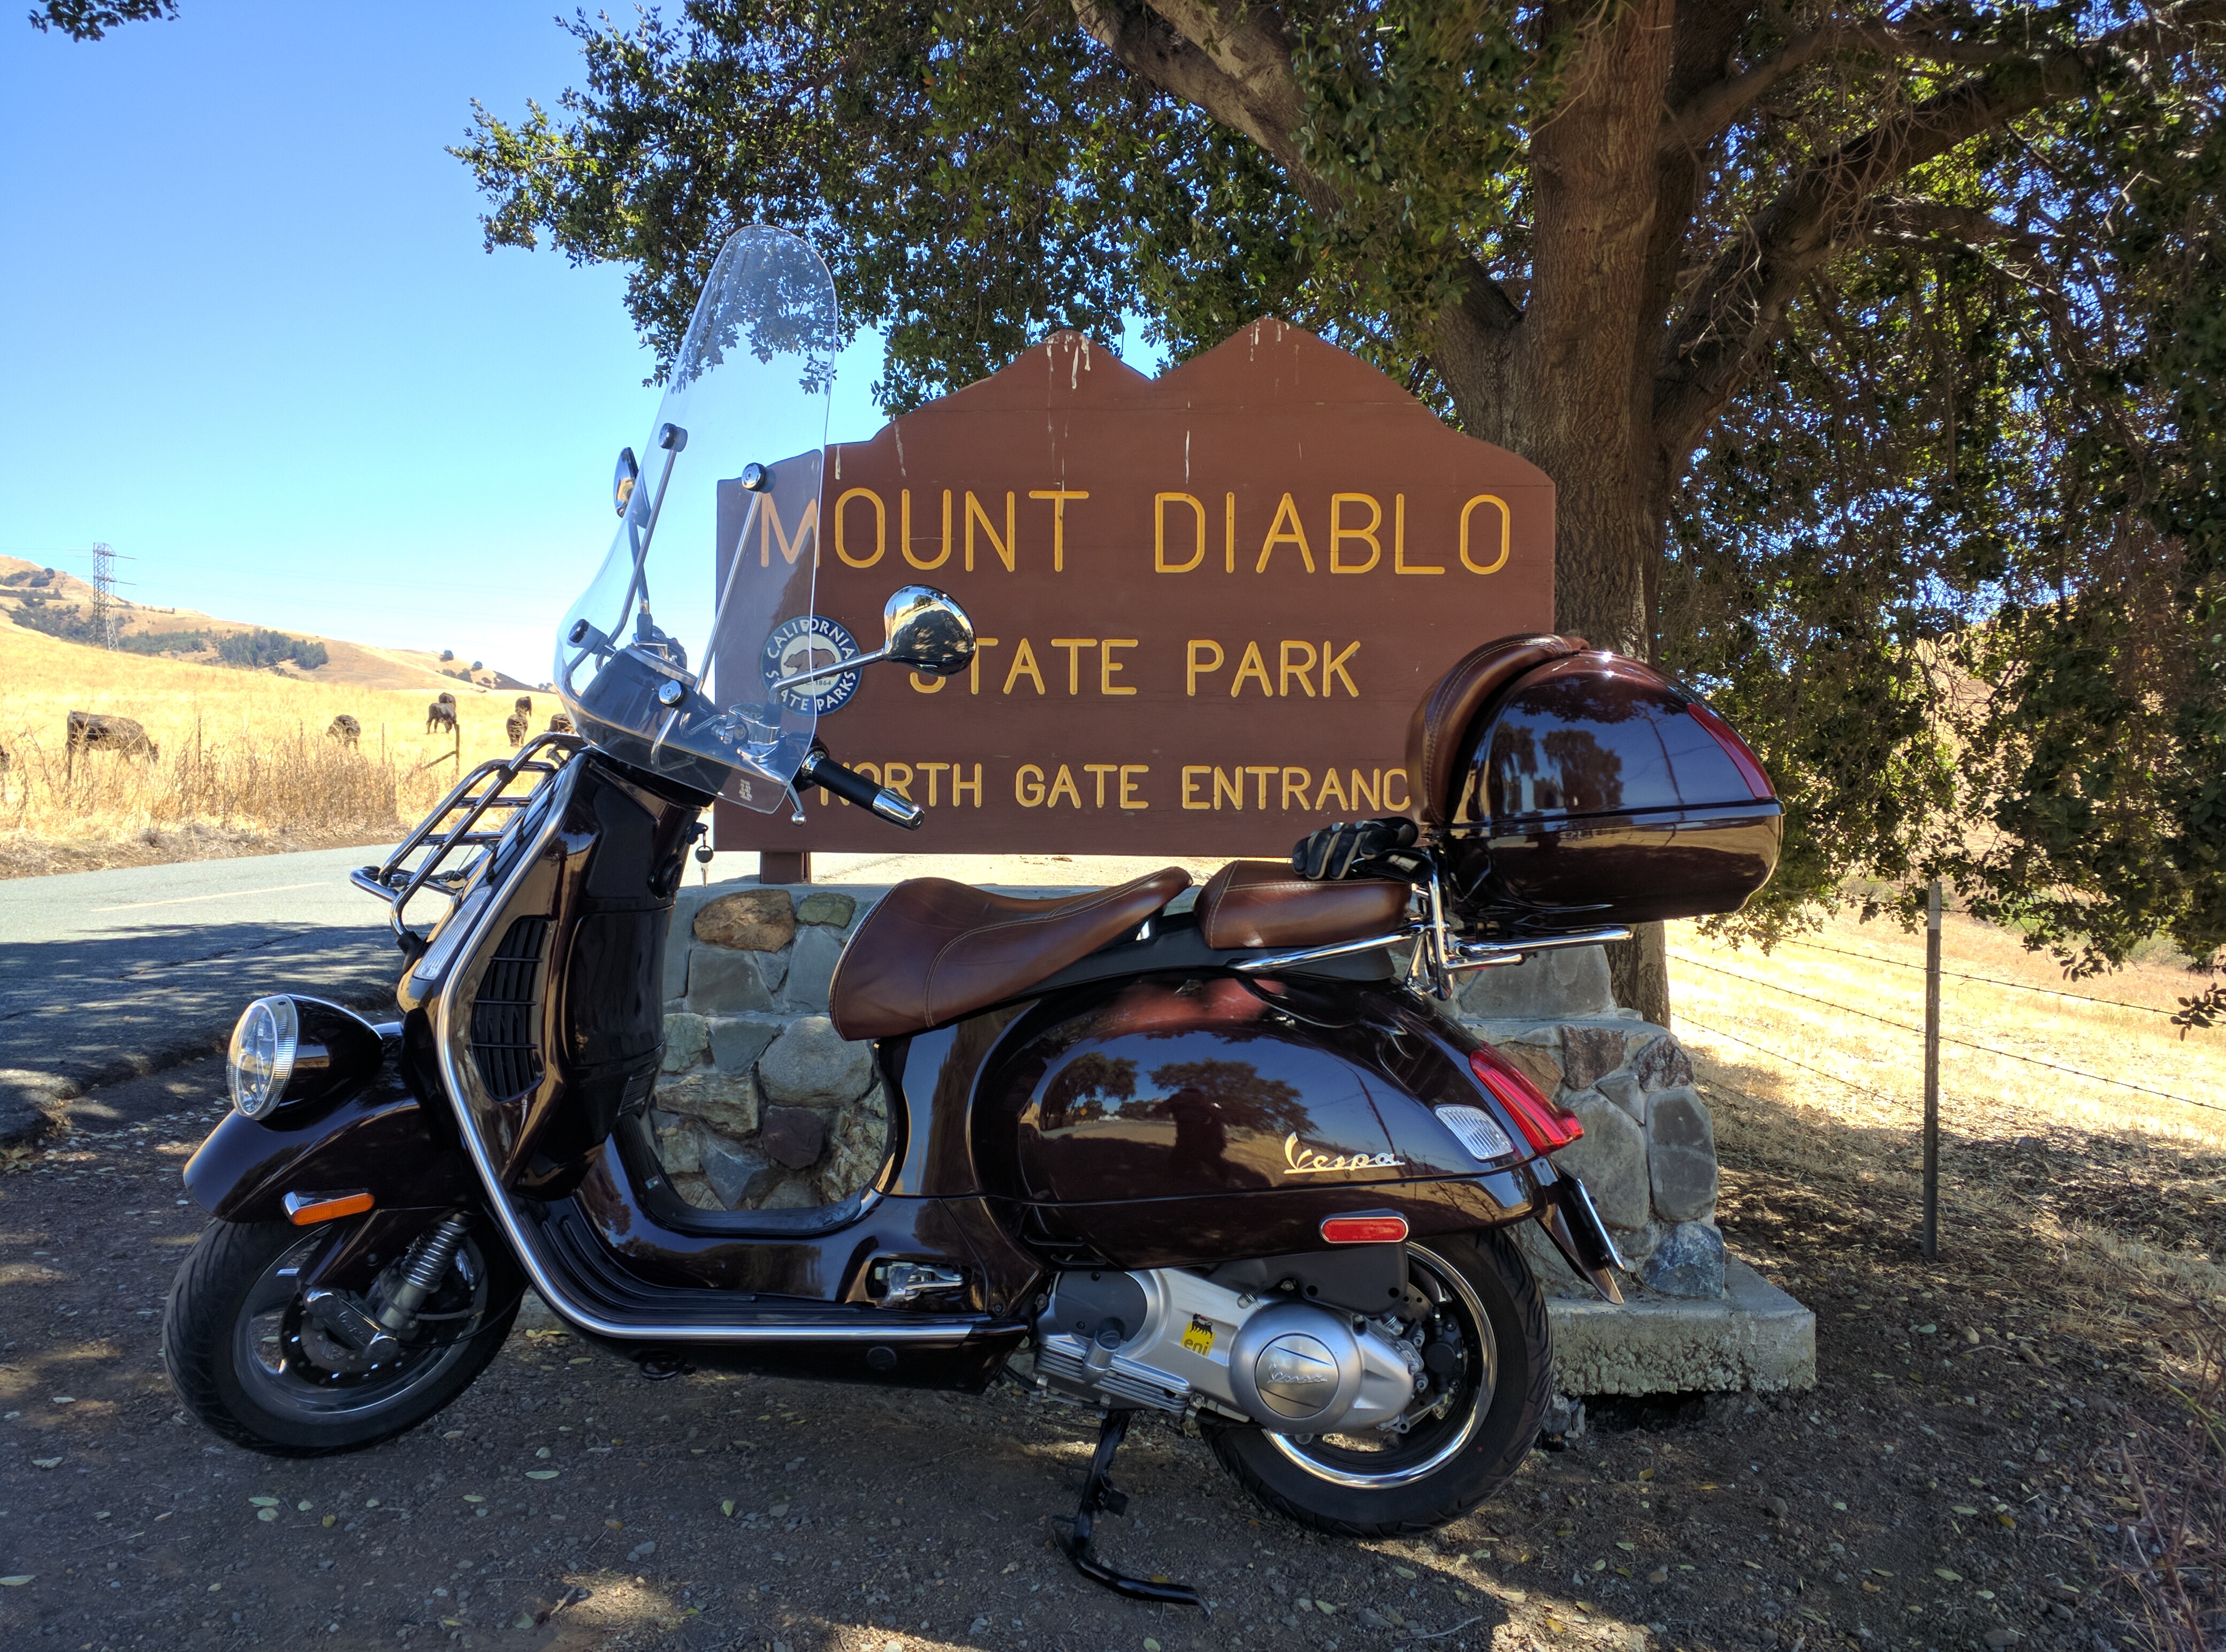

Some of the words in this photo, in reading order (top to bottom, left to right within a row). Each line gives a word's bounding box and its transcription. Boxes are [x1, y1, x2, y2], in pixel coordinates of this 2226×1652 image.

[760, 487, 1089, 572] MOUNT
[1155, 492, 1511, 575] DIABLO
[766, 670, 810, 712] SATE
[816, 671, 856, 711] PARKS
[1187, 639, 1361, 698] PARK
[1015, 764, 1149, 809] GATE
[1181, 765, 1411, 812] ENTRANC
[1284, 1131, 1406, 1174] Vespa
[1184, 1339, 1209, 1355] eni
